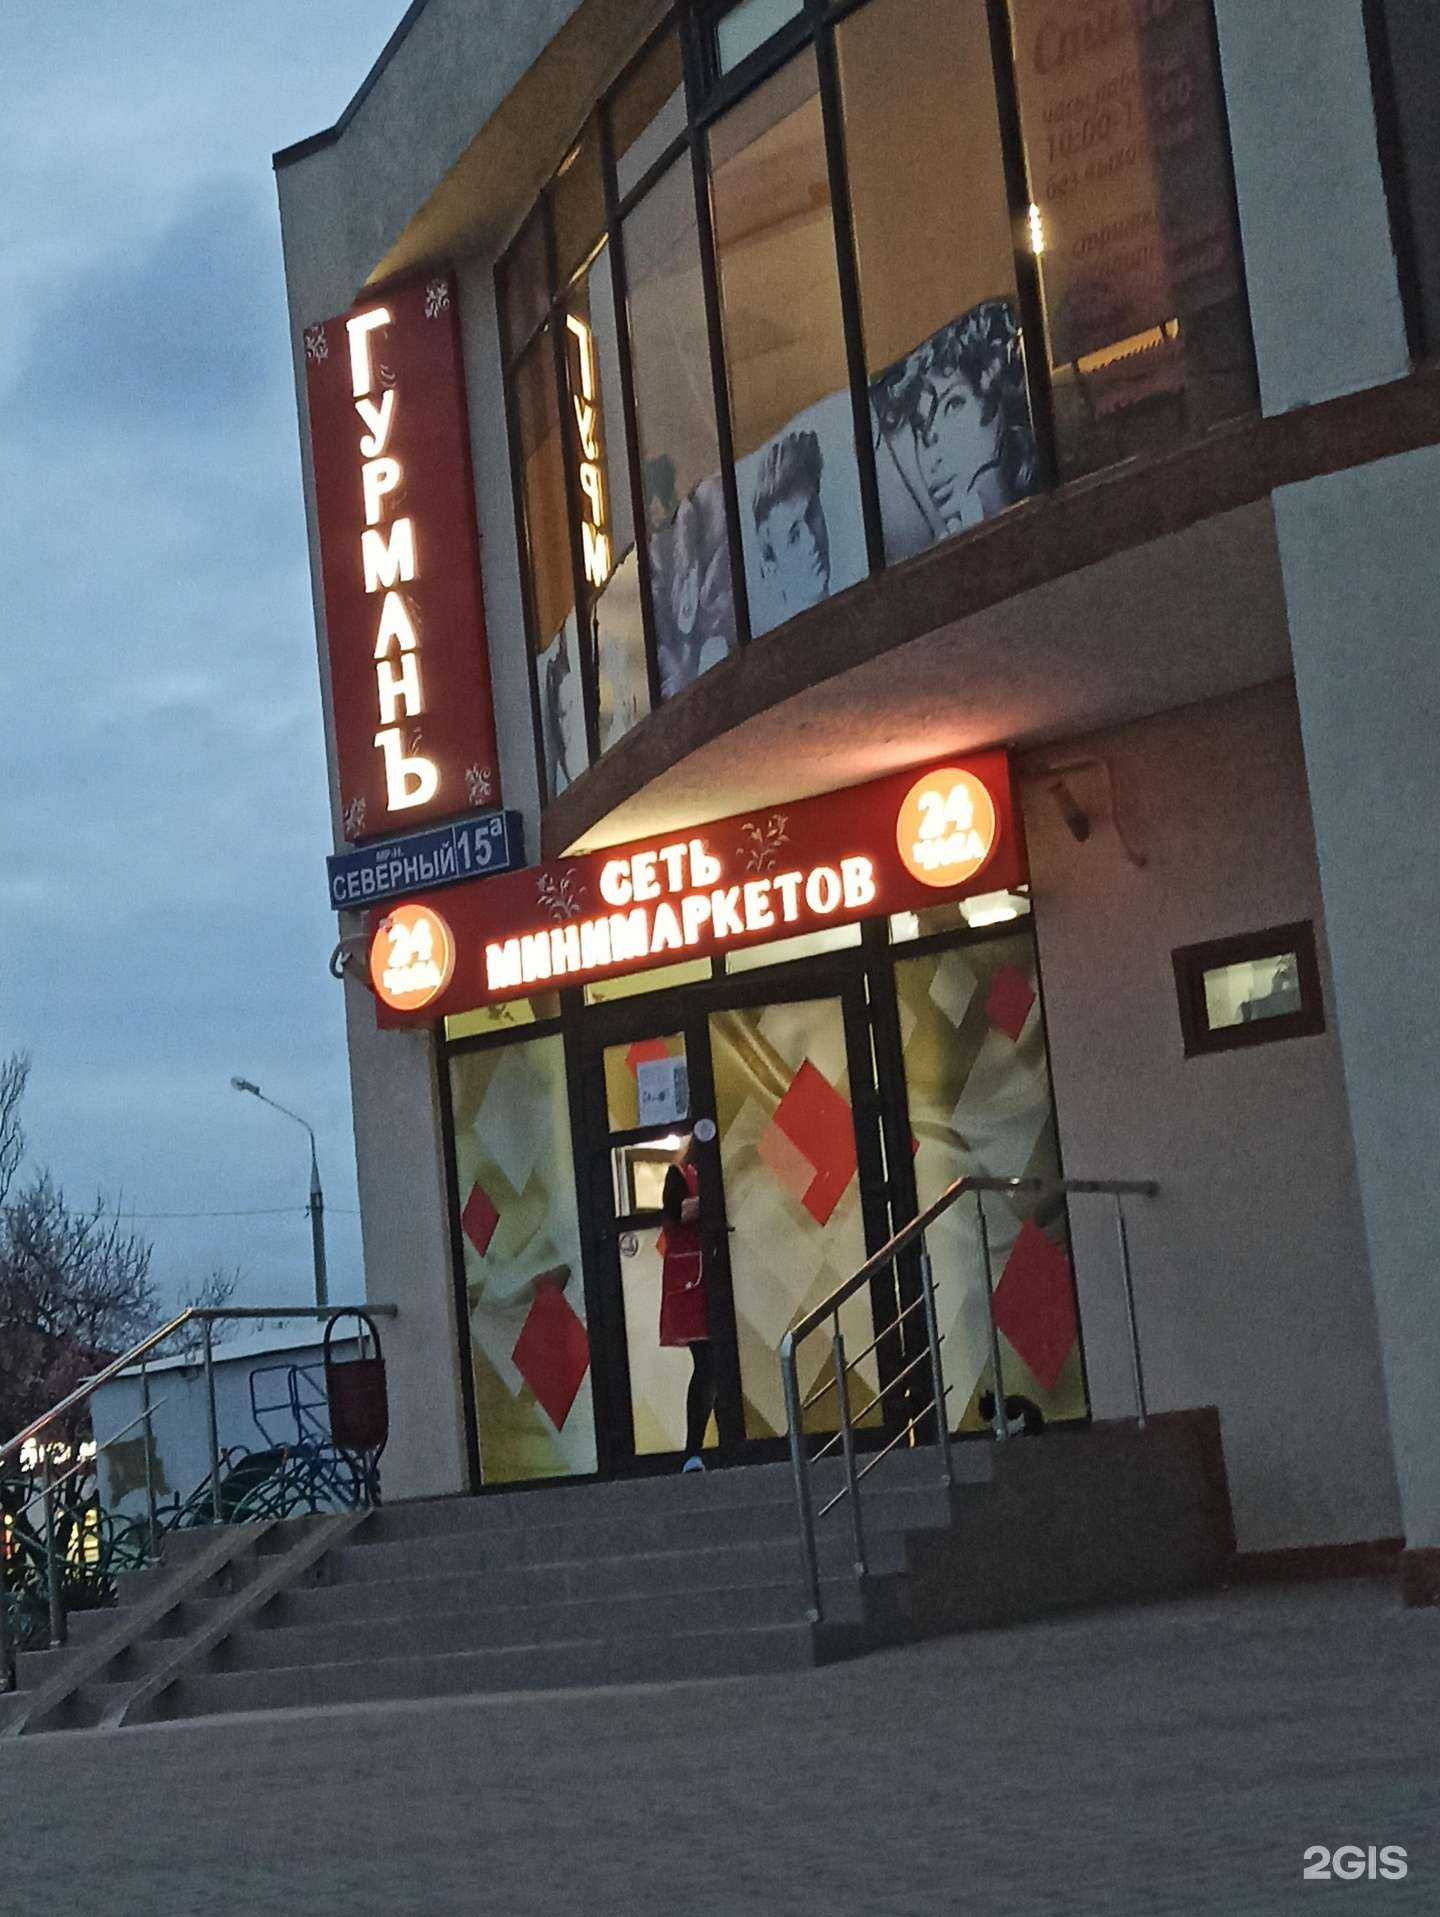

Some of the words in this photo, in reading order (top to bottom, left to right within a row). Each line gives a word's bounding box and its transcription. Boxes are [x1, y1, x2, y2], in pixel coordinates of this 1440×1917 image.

[346, 307, 440, 812] ГУРМАНЪ
[917, 784, 973, 841] 24
[333, 840, 455, 900] СЕВЕРНЫЙ
[600, 839, 721, 906] СЕТЬ
[387, 918, 433, 969] 24
[485, 856, 877, 991] МИНИМАРКЕТОВ
